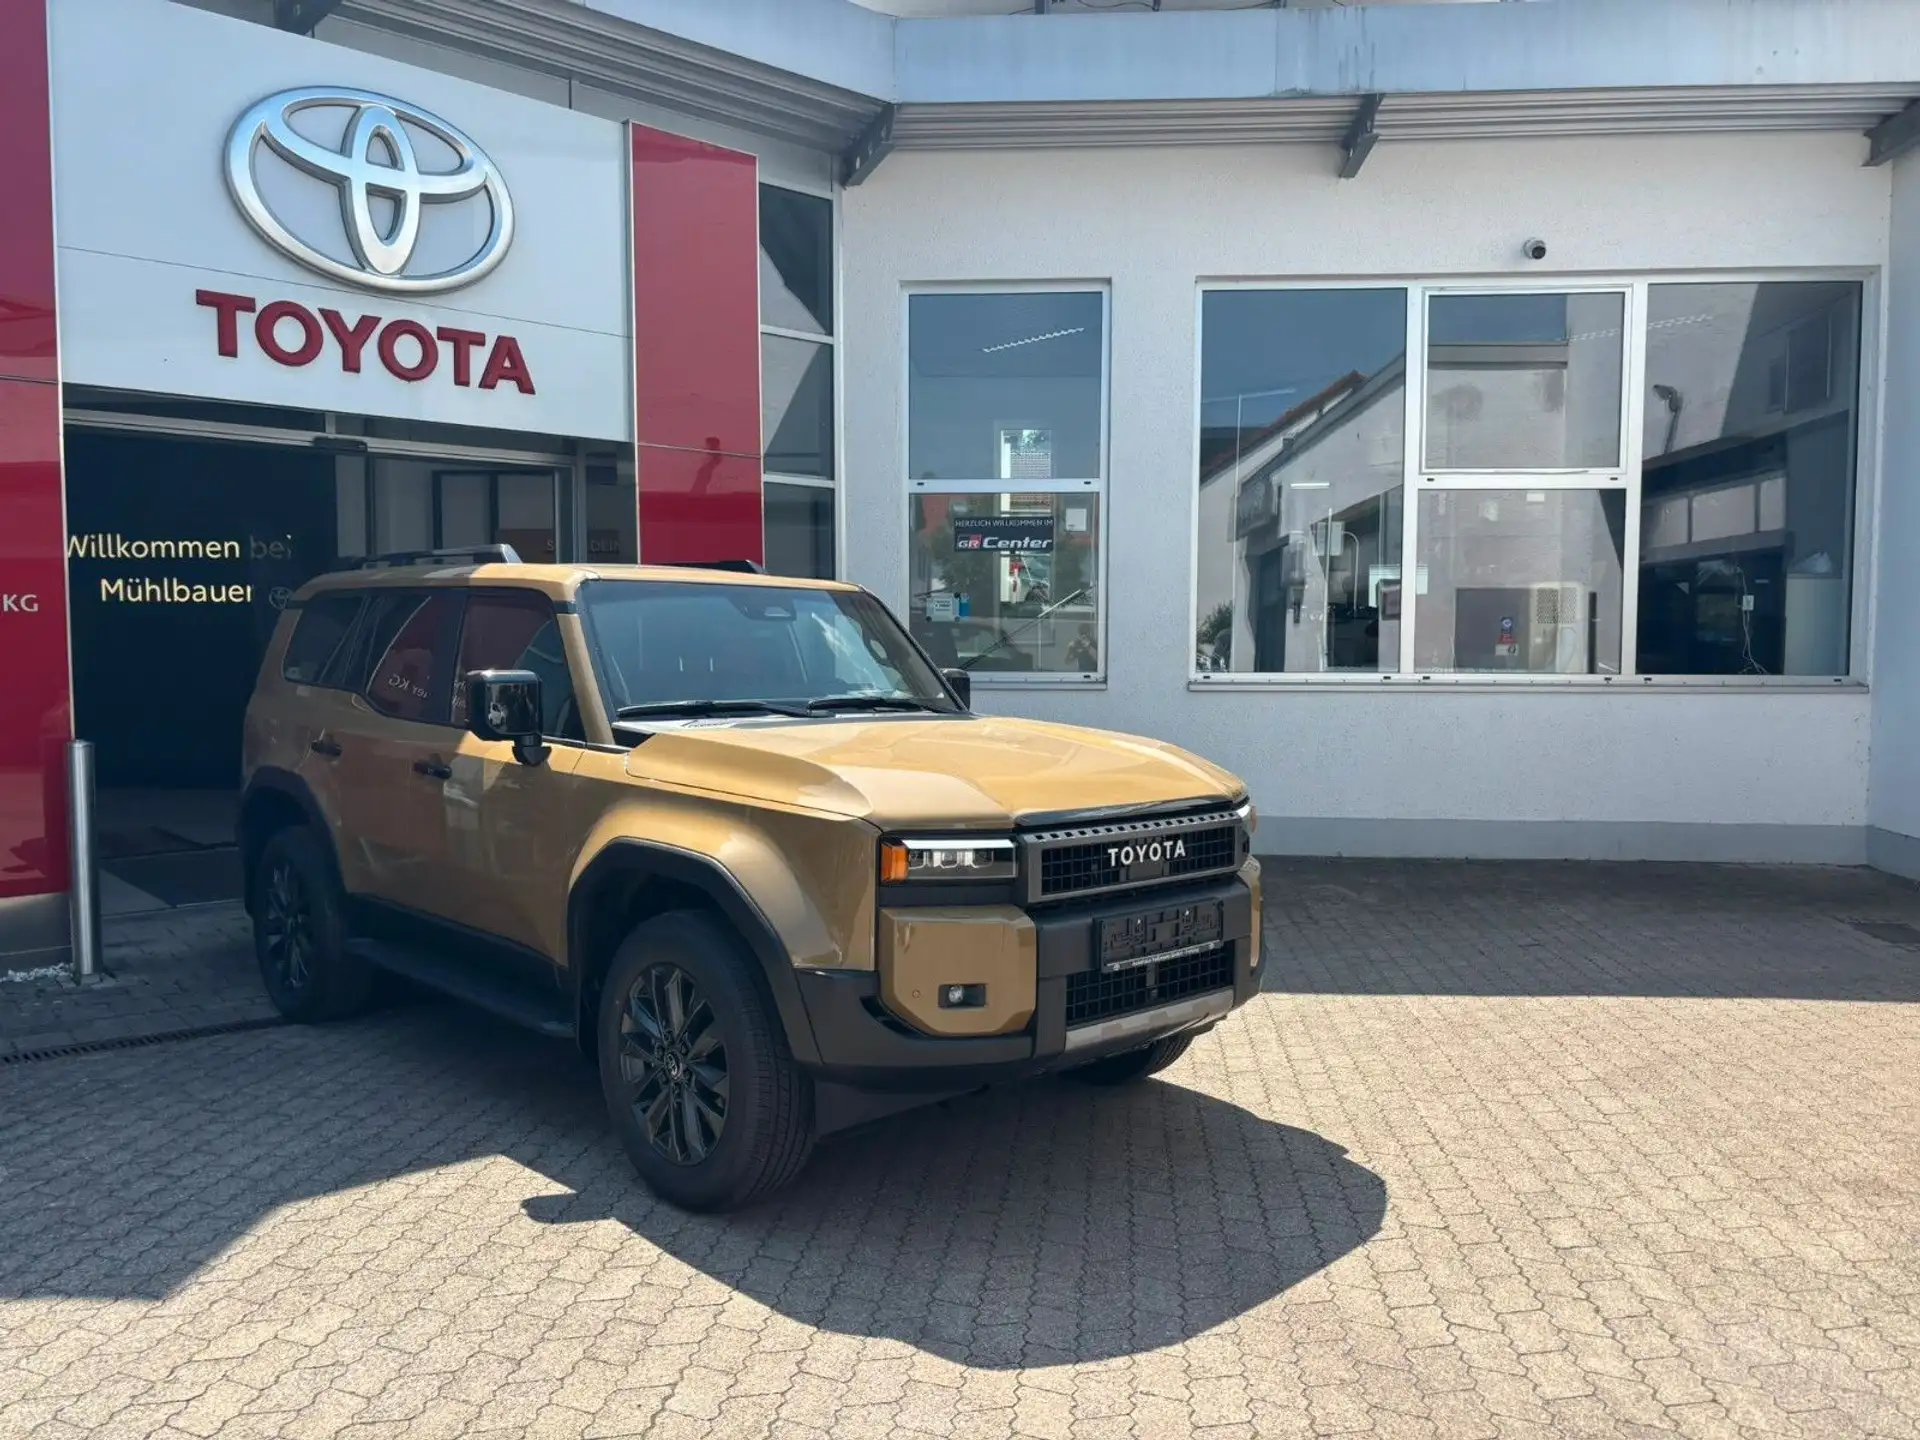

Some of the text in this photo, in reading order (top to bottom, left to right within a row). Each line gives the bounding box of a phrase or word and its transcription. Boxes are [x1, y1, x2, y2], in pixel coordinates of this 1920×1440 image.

[195, 289, 536, 395] TOYOTA
[67, 534, 240, 558] Willkommen
[958, 536, 1053, 549] GR Center
[3, 594, 38, 612] KG
[1107, 839, 1186, 867] TOYOTA
